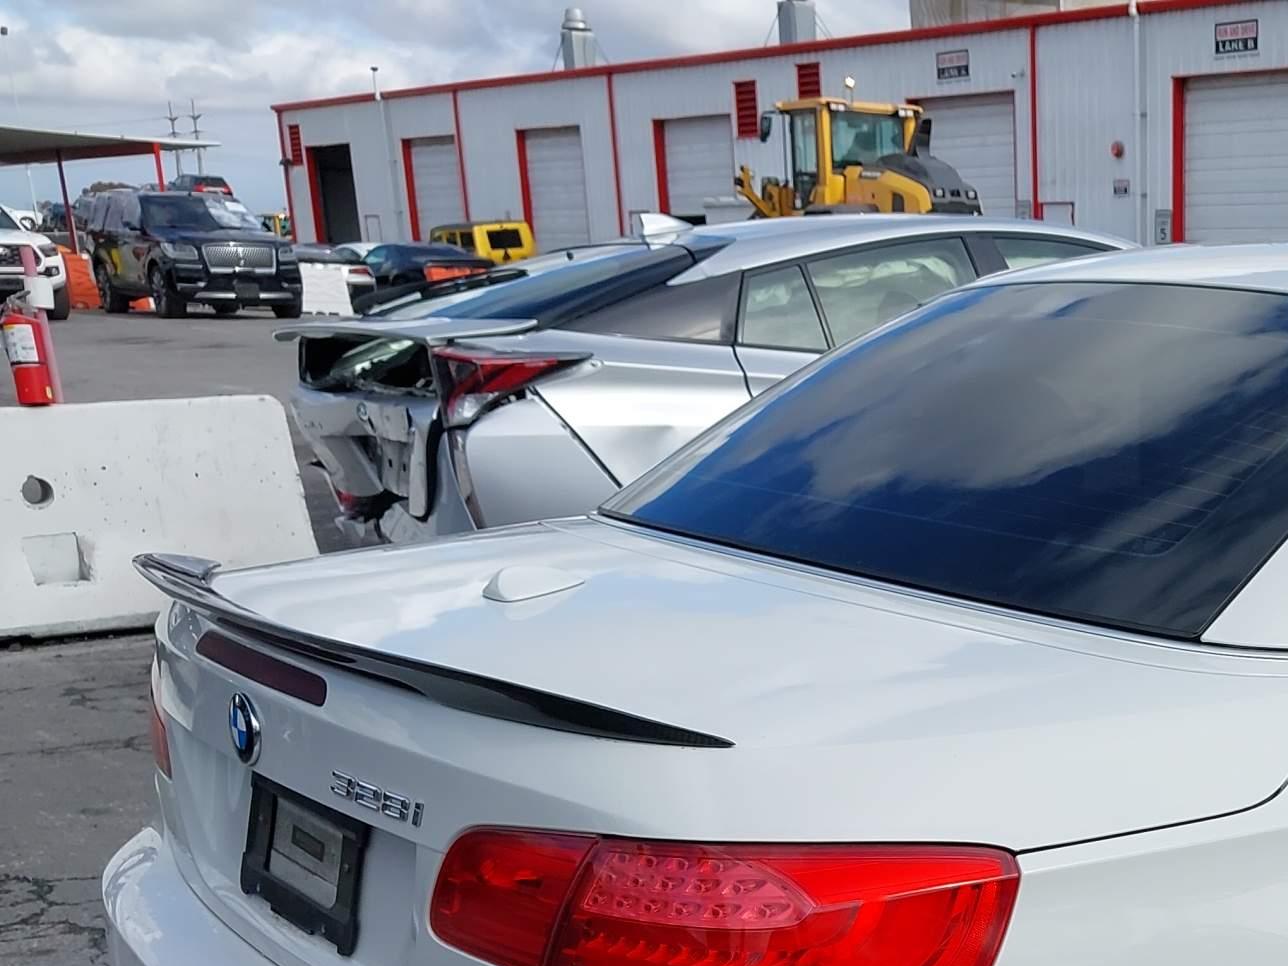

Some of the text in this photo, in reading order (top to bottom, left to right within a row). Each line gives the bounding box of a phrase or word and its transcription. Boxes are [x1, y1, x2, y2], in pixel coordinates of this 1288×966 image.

[1219, 39, 1245, 51] LANE
[1160, 227, 1167, 241] 5
[329, 768, 425, 828] 328i
